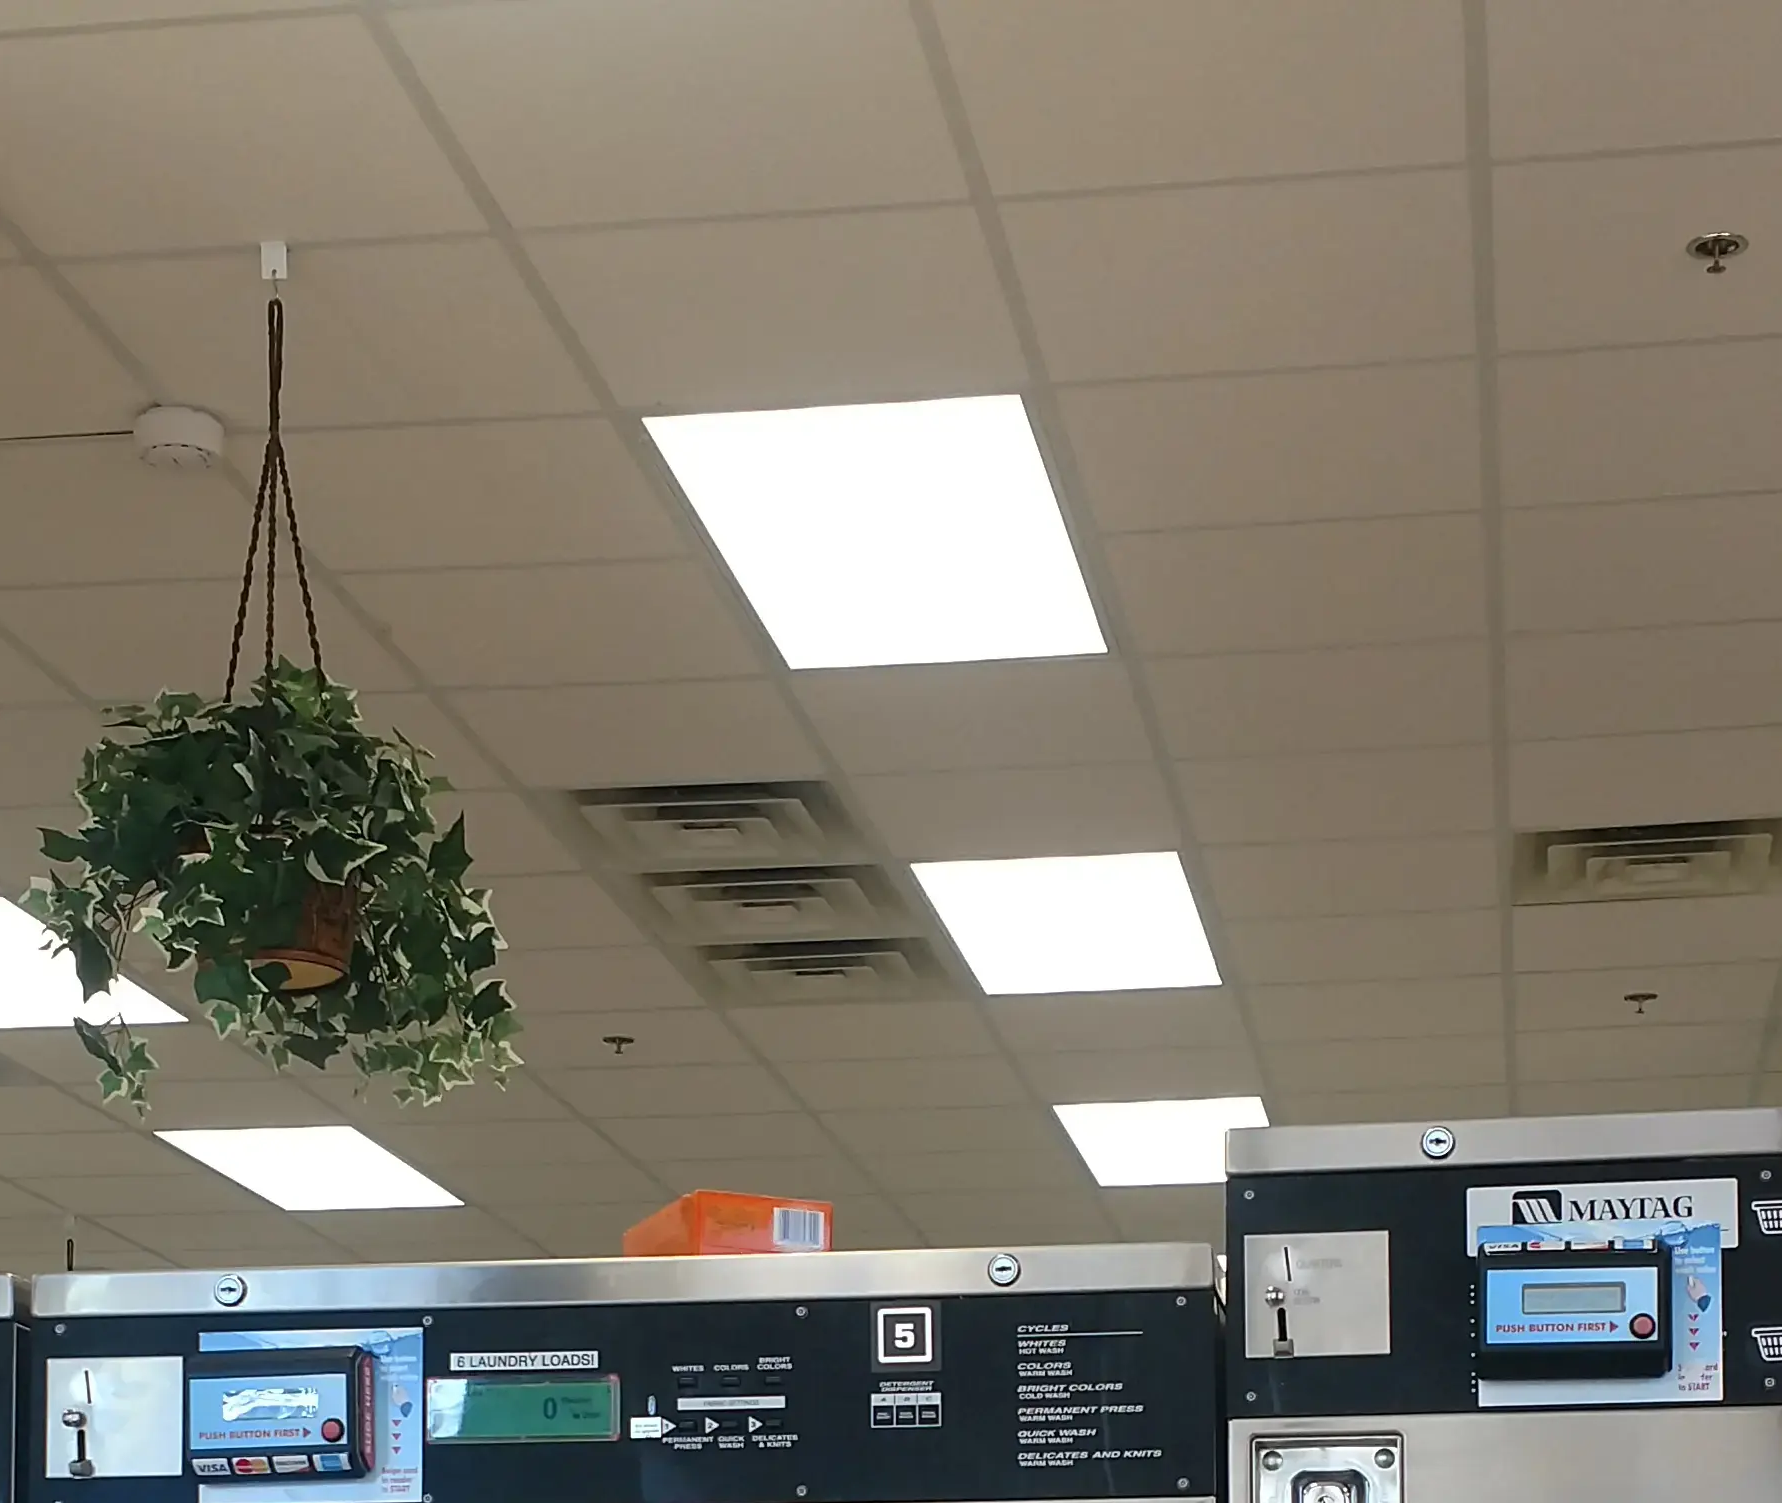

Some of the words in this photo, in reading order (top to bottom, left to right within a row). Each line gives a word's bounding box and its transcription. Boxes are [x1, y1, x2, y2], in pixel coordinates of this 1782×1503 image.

[1568, 1196, 1693, 1221] MAYTAG
[1017, 1324, 1068, 1332] CYCLES
[1496, 1324, 1525, 1333] PUSH
[1529, 1323, 1574, 1332] BUTTON
[1577, 1322, 1606, 1331] FIRST
[895, 1323, 915, 1348] 5
[457, 1356, 465, 1368] 6
[470, 1355, 538, 1368] LAUNDRY
[542, 1354, 595, 1367] LOADS!
[1017, 1362, 1071, 1370] COLORS
[1069, 1383, 1123, 1391] COLORS
[1018, 1406, 1098, 1415] PERMANENT
[1100, 1405, 1144, 1413] PRESS
[199, 1431, 225, 1440] PUSH
[229, 1430, 271, 1439] BUTTON
[274, 1428, 300, 1437] FIRST
[1018, 1452, 1088, 1460] DELICATES
[1124, 1450, 1162, 1458] KNITS
[196, 1463, 227, 1473] VISA
